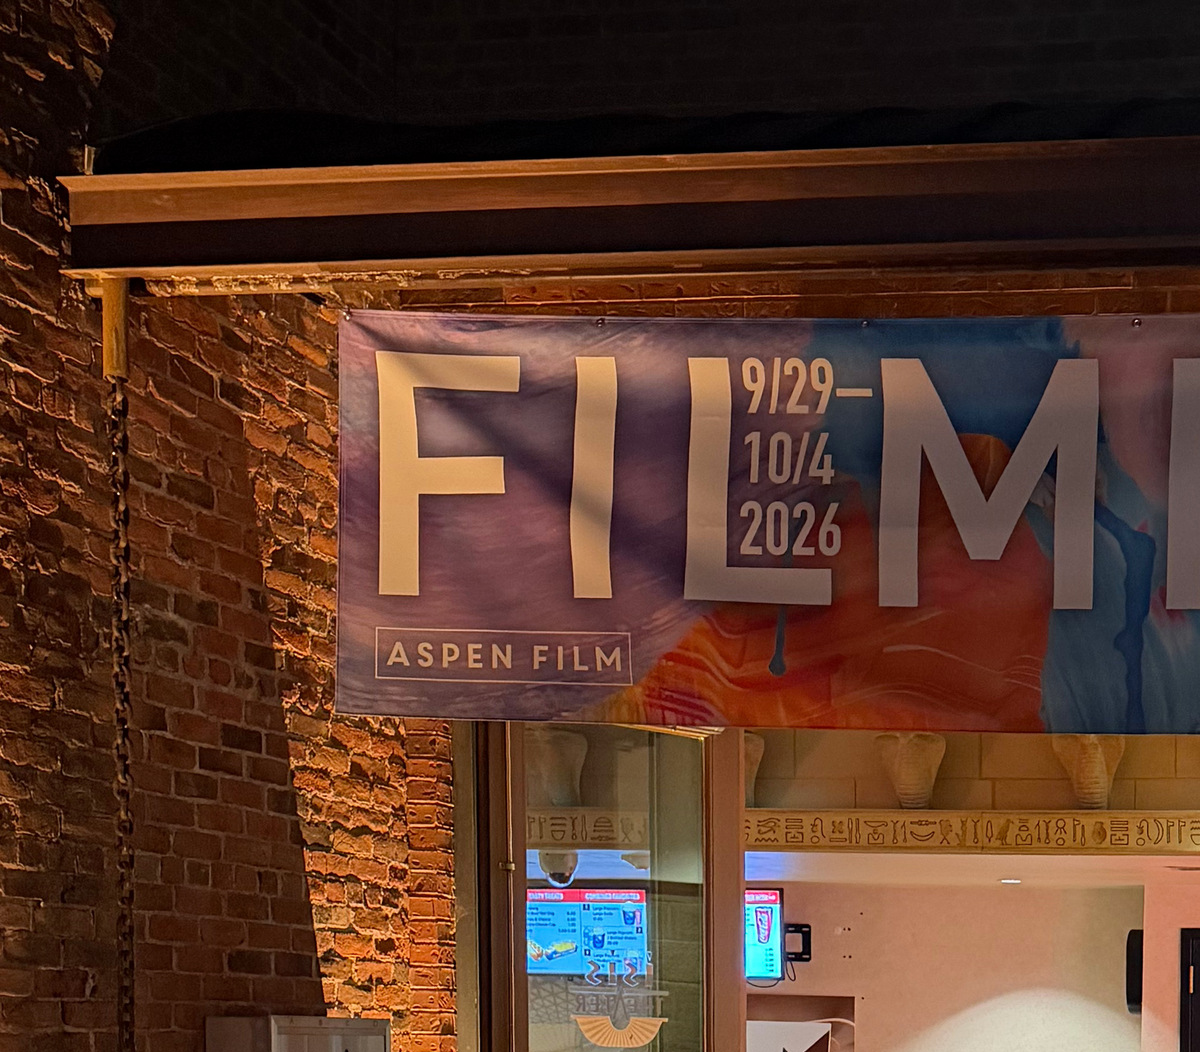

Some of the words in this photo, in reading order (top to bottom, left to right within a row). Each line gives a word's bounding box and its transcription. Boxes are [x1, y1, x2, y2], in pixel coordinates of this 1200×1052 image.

[744, 430, 836, 487] 10/4
[739, 502, 842, 557] 2026
[387, 641, 512, 670] ASPEN
[533, 645, 623, 673] FILM
